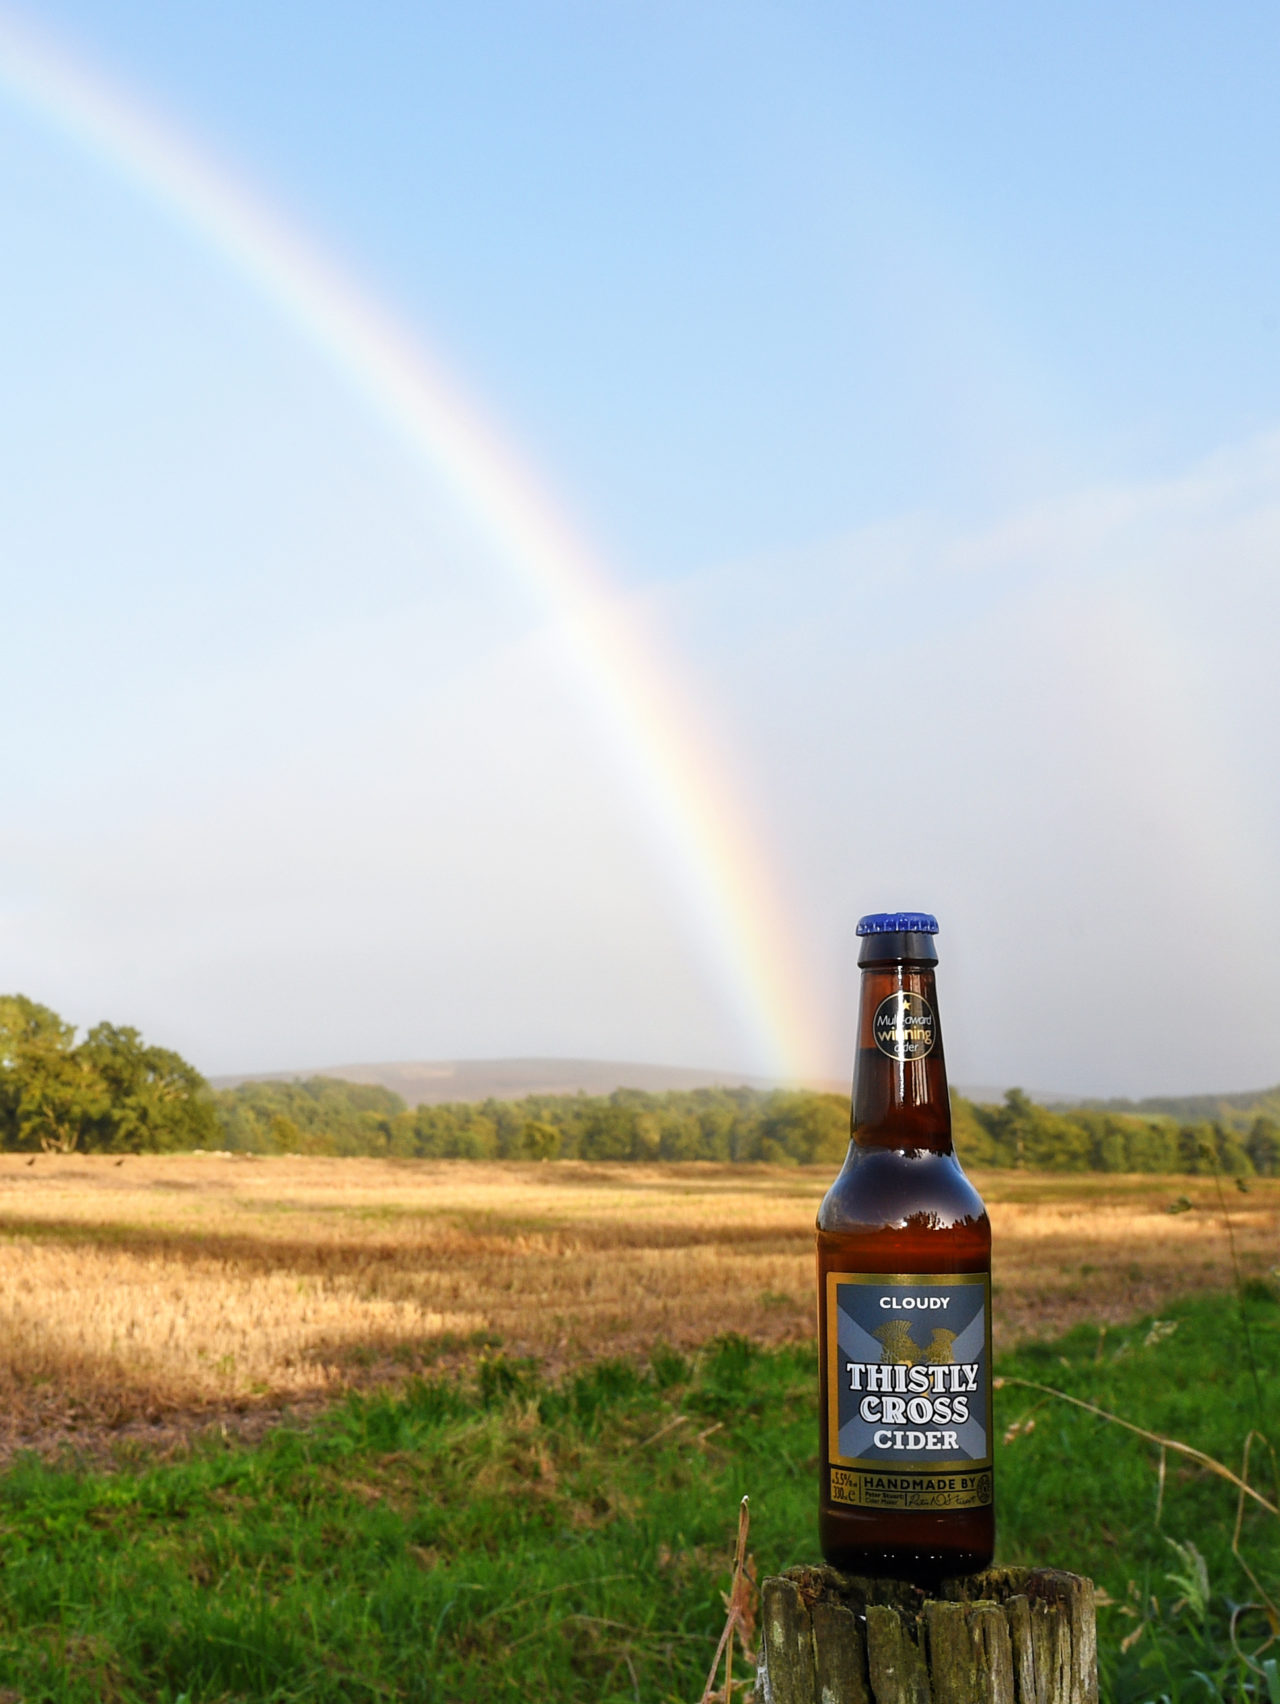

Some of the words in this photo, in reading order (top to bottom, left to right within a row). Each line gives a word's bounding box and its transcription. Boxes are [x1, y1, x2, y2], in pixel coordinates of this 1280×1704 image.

[877, 1014, 931, 1026] Mul-award
[894, 1042, 919, 1053] cder
[879, 1297, 950, 1309] CLOUDY
[846, 1362, 979, 1393] THISTLY
[859, 1395, 969, 1424] CROSS
[873, 1430, 960, 1450] CIDER
[864, 1477, 955, 1490] HANDMADE
[961, 1477, 976, 1488] BY
